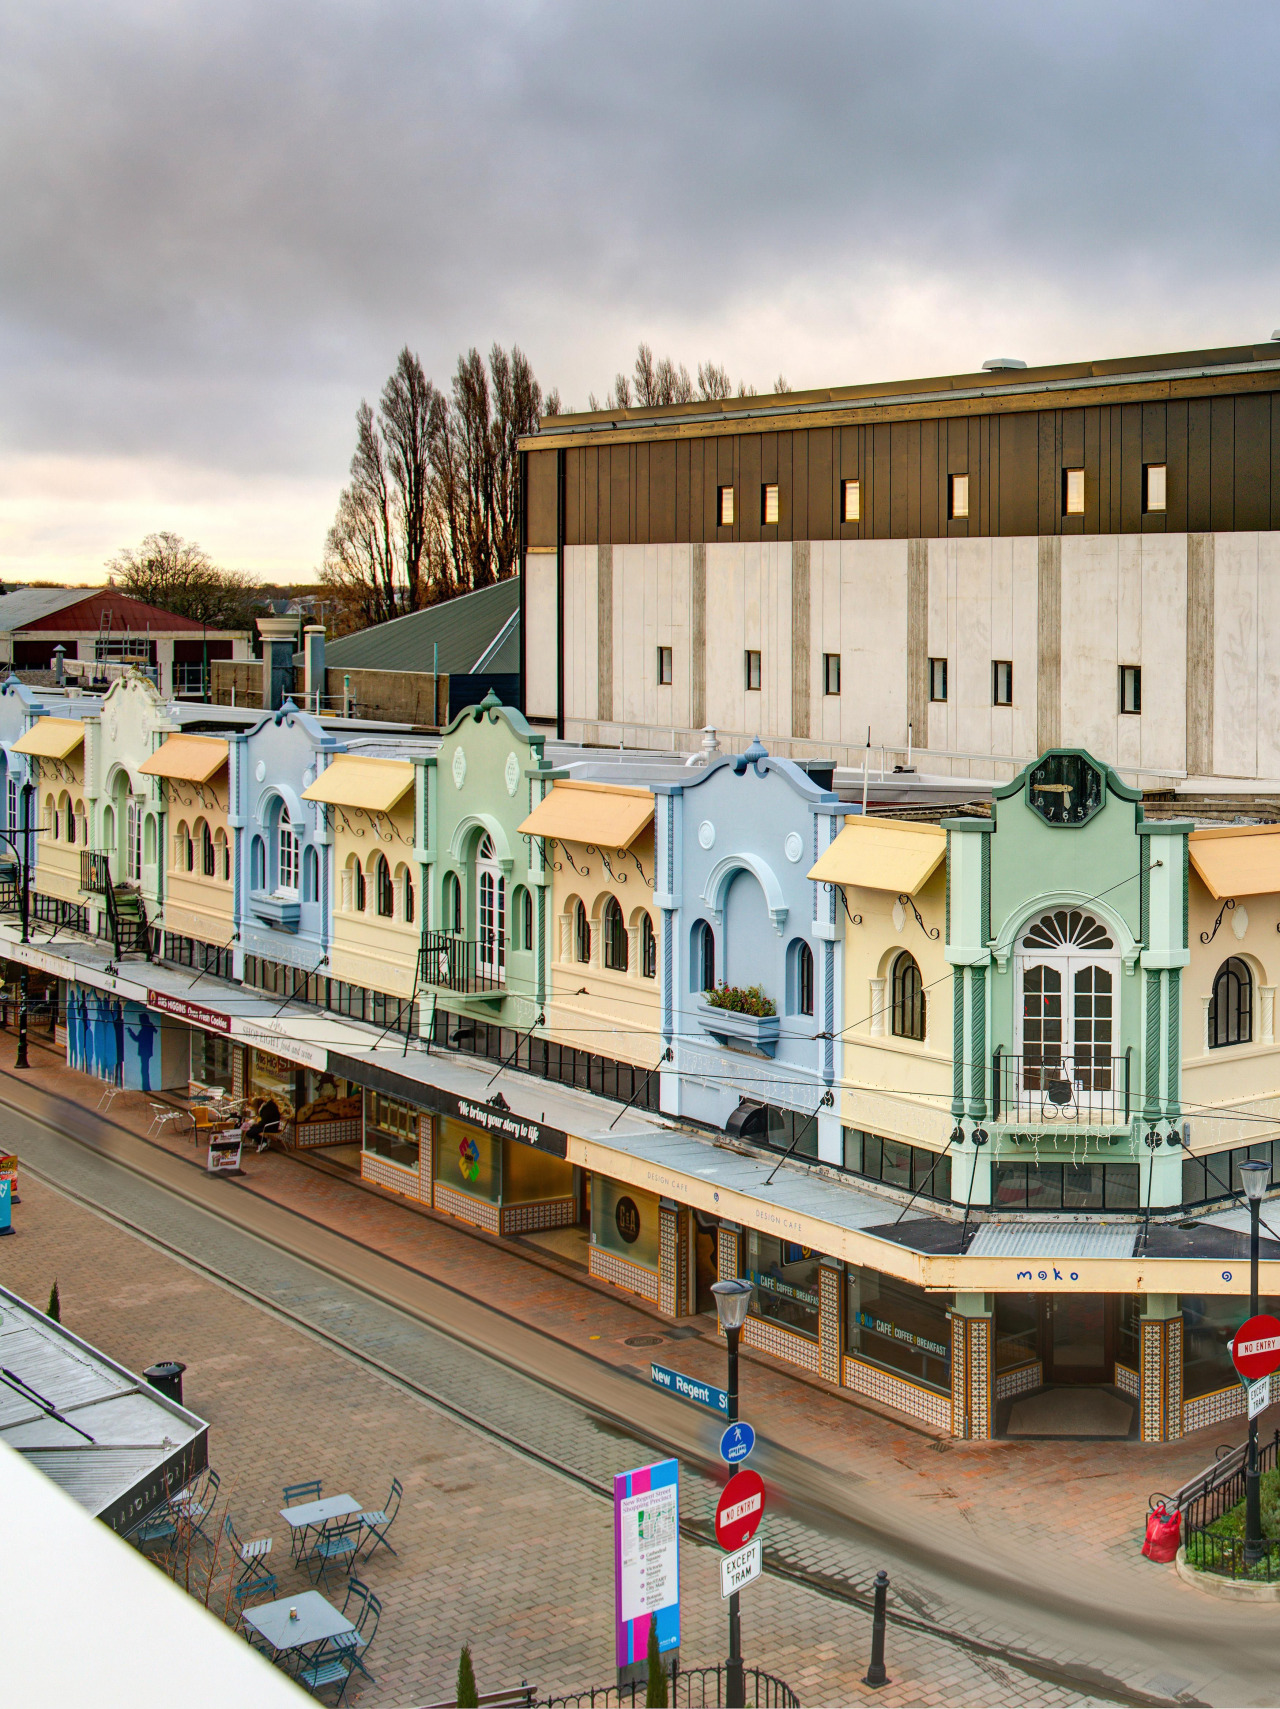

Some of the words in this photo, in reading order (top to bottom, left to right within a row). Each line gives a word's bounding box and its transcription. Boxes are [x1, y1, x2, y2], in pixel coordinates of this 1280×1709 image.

[1035, 770, 1045, 779] 10
[1086, 798, 1093, 806] 4
[1049, 807, 1054, 816] 7
[1063, 811, 1069, 819] 6
[1077, 807, 1083, 816] 5
[168, 1000, 186, 1014] HIGGINS
[199, 1010, 210, 1023] Fresh
[211, 1015, 228, 1029] Cookies
[259, 1032, 279, 1048] EIGHT
[458, 1101, 469, 1116] We
[469, 1105, 487, 1127] bring
[487, 1111, 503, 1129] your
[503, 1118, 520, 1138] story
[520, 1124, 528, 1137] to
[528, 1126, 539, 1144] life
[647, 1171, 669, 1185] DESIGN
[672, 1180, 688, 1192] CAFE
[755, 1209, 781, 1225] DESIGN
[783, 1219, 802, 1232] CAFE
[1016, 1267, 1078, 1281] moko
[776, 1281, 793, 1297] COFFEE
[894, 1327, 913, 1344] COFFEE
[916, 1336, 946, 1357] BREAKFAST
[1244, 1343, 1253, 1353] NO
[1256, 1339, 1276, 1352] ENTRY
[651, 1366, 670, 1385] New
[676, 1376, 709, 1402] Regent
[1250, 1381, 1267, 1401] EXCEPT
[1253, 1395, 1265, 1411] TRAM
[623, 1499, 635, 1507] New
[636, 1493, 655, 1504] Regent
[656, 1488, 671, 1496] Street
[623, 1501, 649, 1512] Shopping
[650, 1494, 672, 1505] Precinct
[726, 1507, 734, 1522] NO
[736, 1498, 755, 1517] ENTRY
[646, 1547, 667, 1558] Cathedral
[646, 1563, 662, 1572] Victoria
[726, 1548, 755, 1574] EXCEPT
[731, 1564, 752, 1586] TRAM
[646, 1584, 654, 1592] City
[655, 1581, 665, 1589] Mall
[646, 1596, 664, 1605] Gardens
